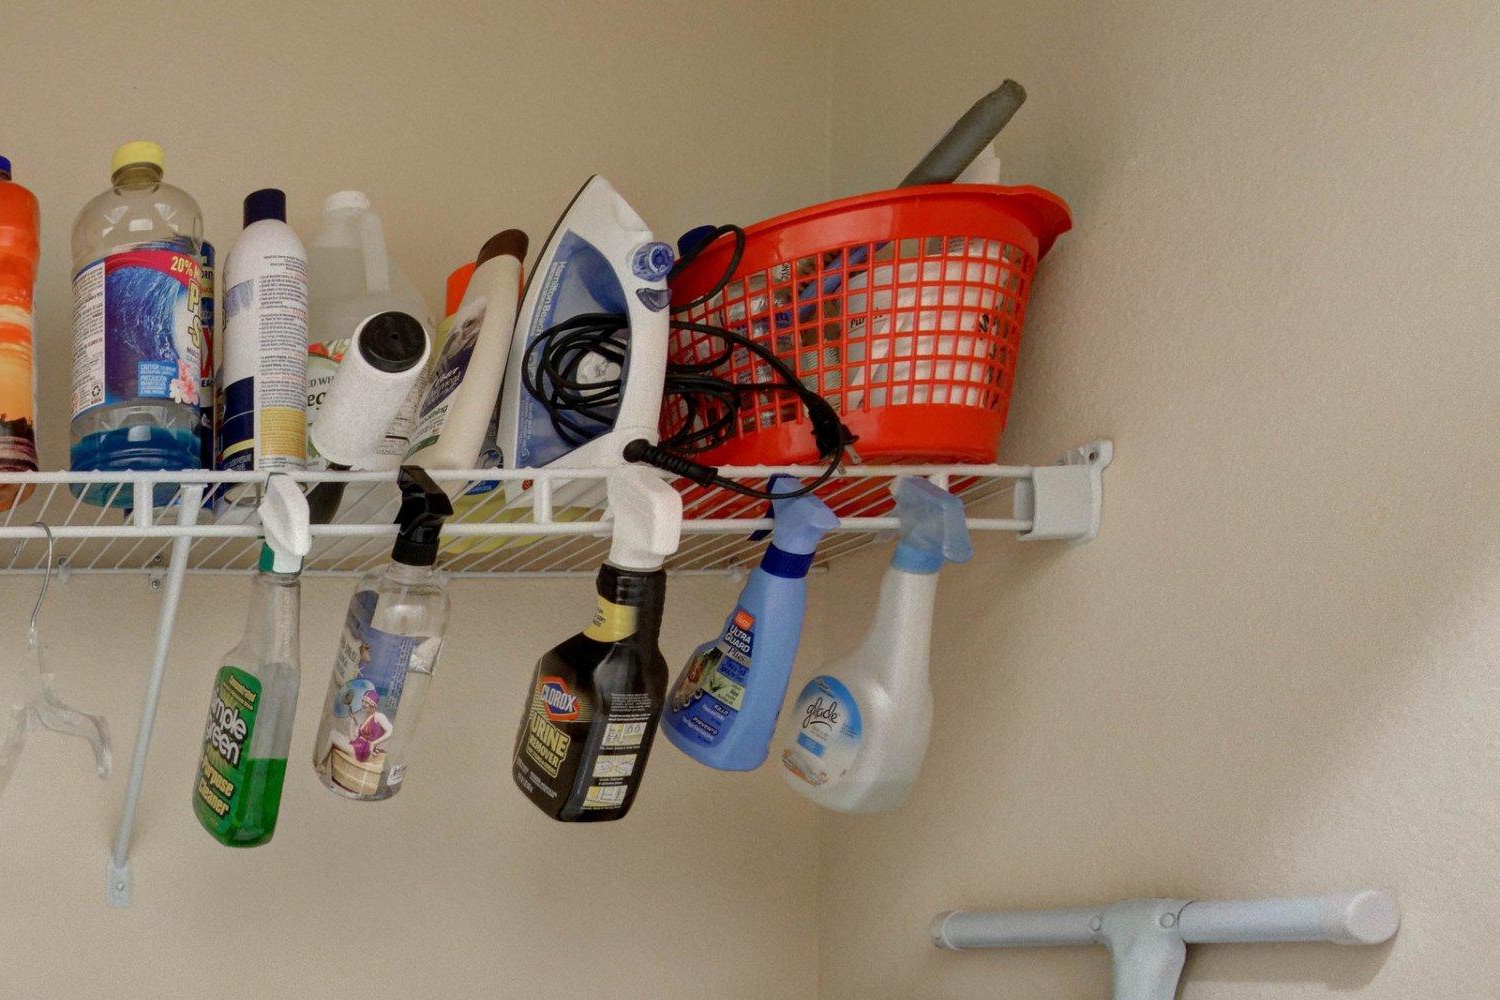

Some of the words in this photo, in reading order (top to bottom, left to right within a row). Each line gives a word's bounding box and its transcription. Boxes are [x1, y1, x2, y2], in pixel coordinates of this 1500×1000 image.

[171, 256, 194, 277] 20%
[725, 632, 751, 653] GUARD
[729, 624, 752, 644] ULTRA
[542, 684, 576, 713] CLOROX
[802, 696, 838, 729] glade
[531, 710, 570, 757] URINE
